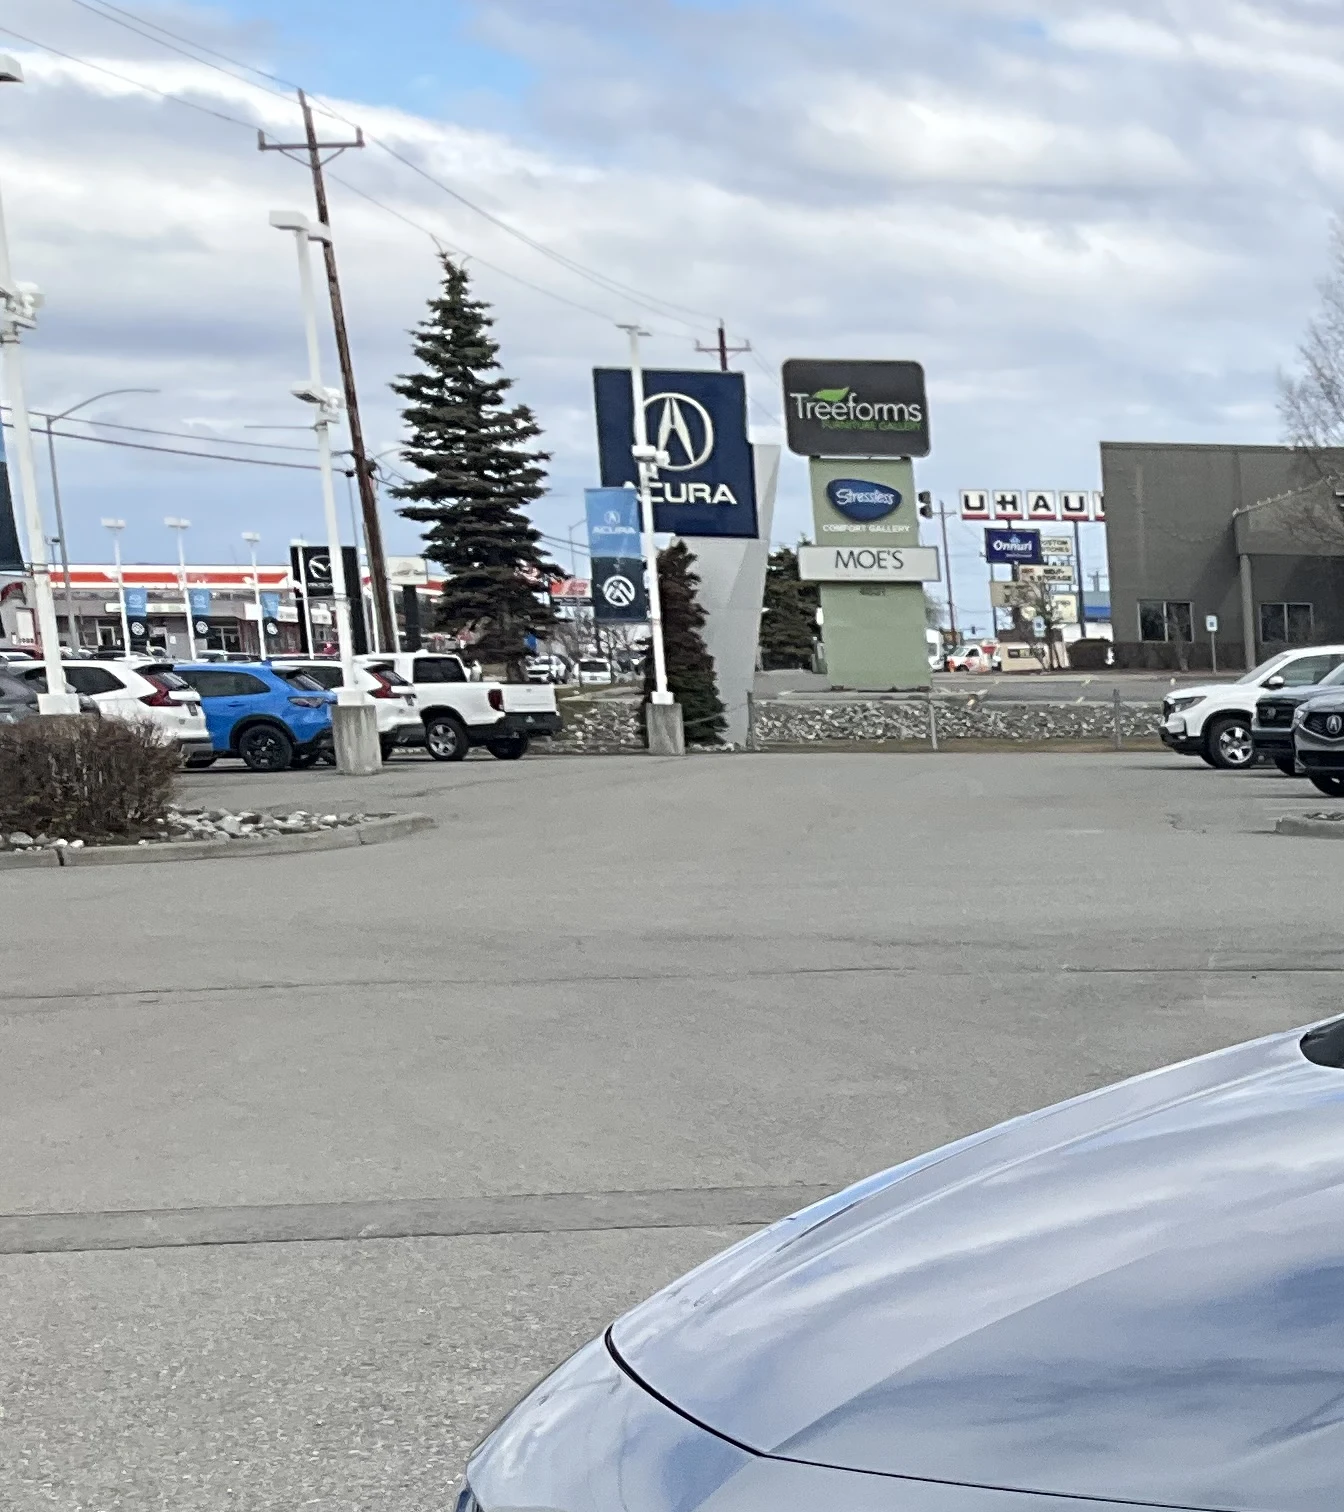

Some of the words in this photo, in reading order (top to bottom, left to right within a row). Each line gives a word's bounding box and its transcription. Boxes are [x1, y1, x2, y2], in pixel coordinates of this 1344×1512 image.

[790, 392, 922, 421] Treeforms
[835, 488, 895, 505] Stressless
[592, 525, 637, 534] ACURA
[822, 524, 866, 532] COMFORT
[868, 525, 911, 533] GALLERY
[835, 549, 904, 570] MOE'S
